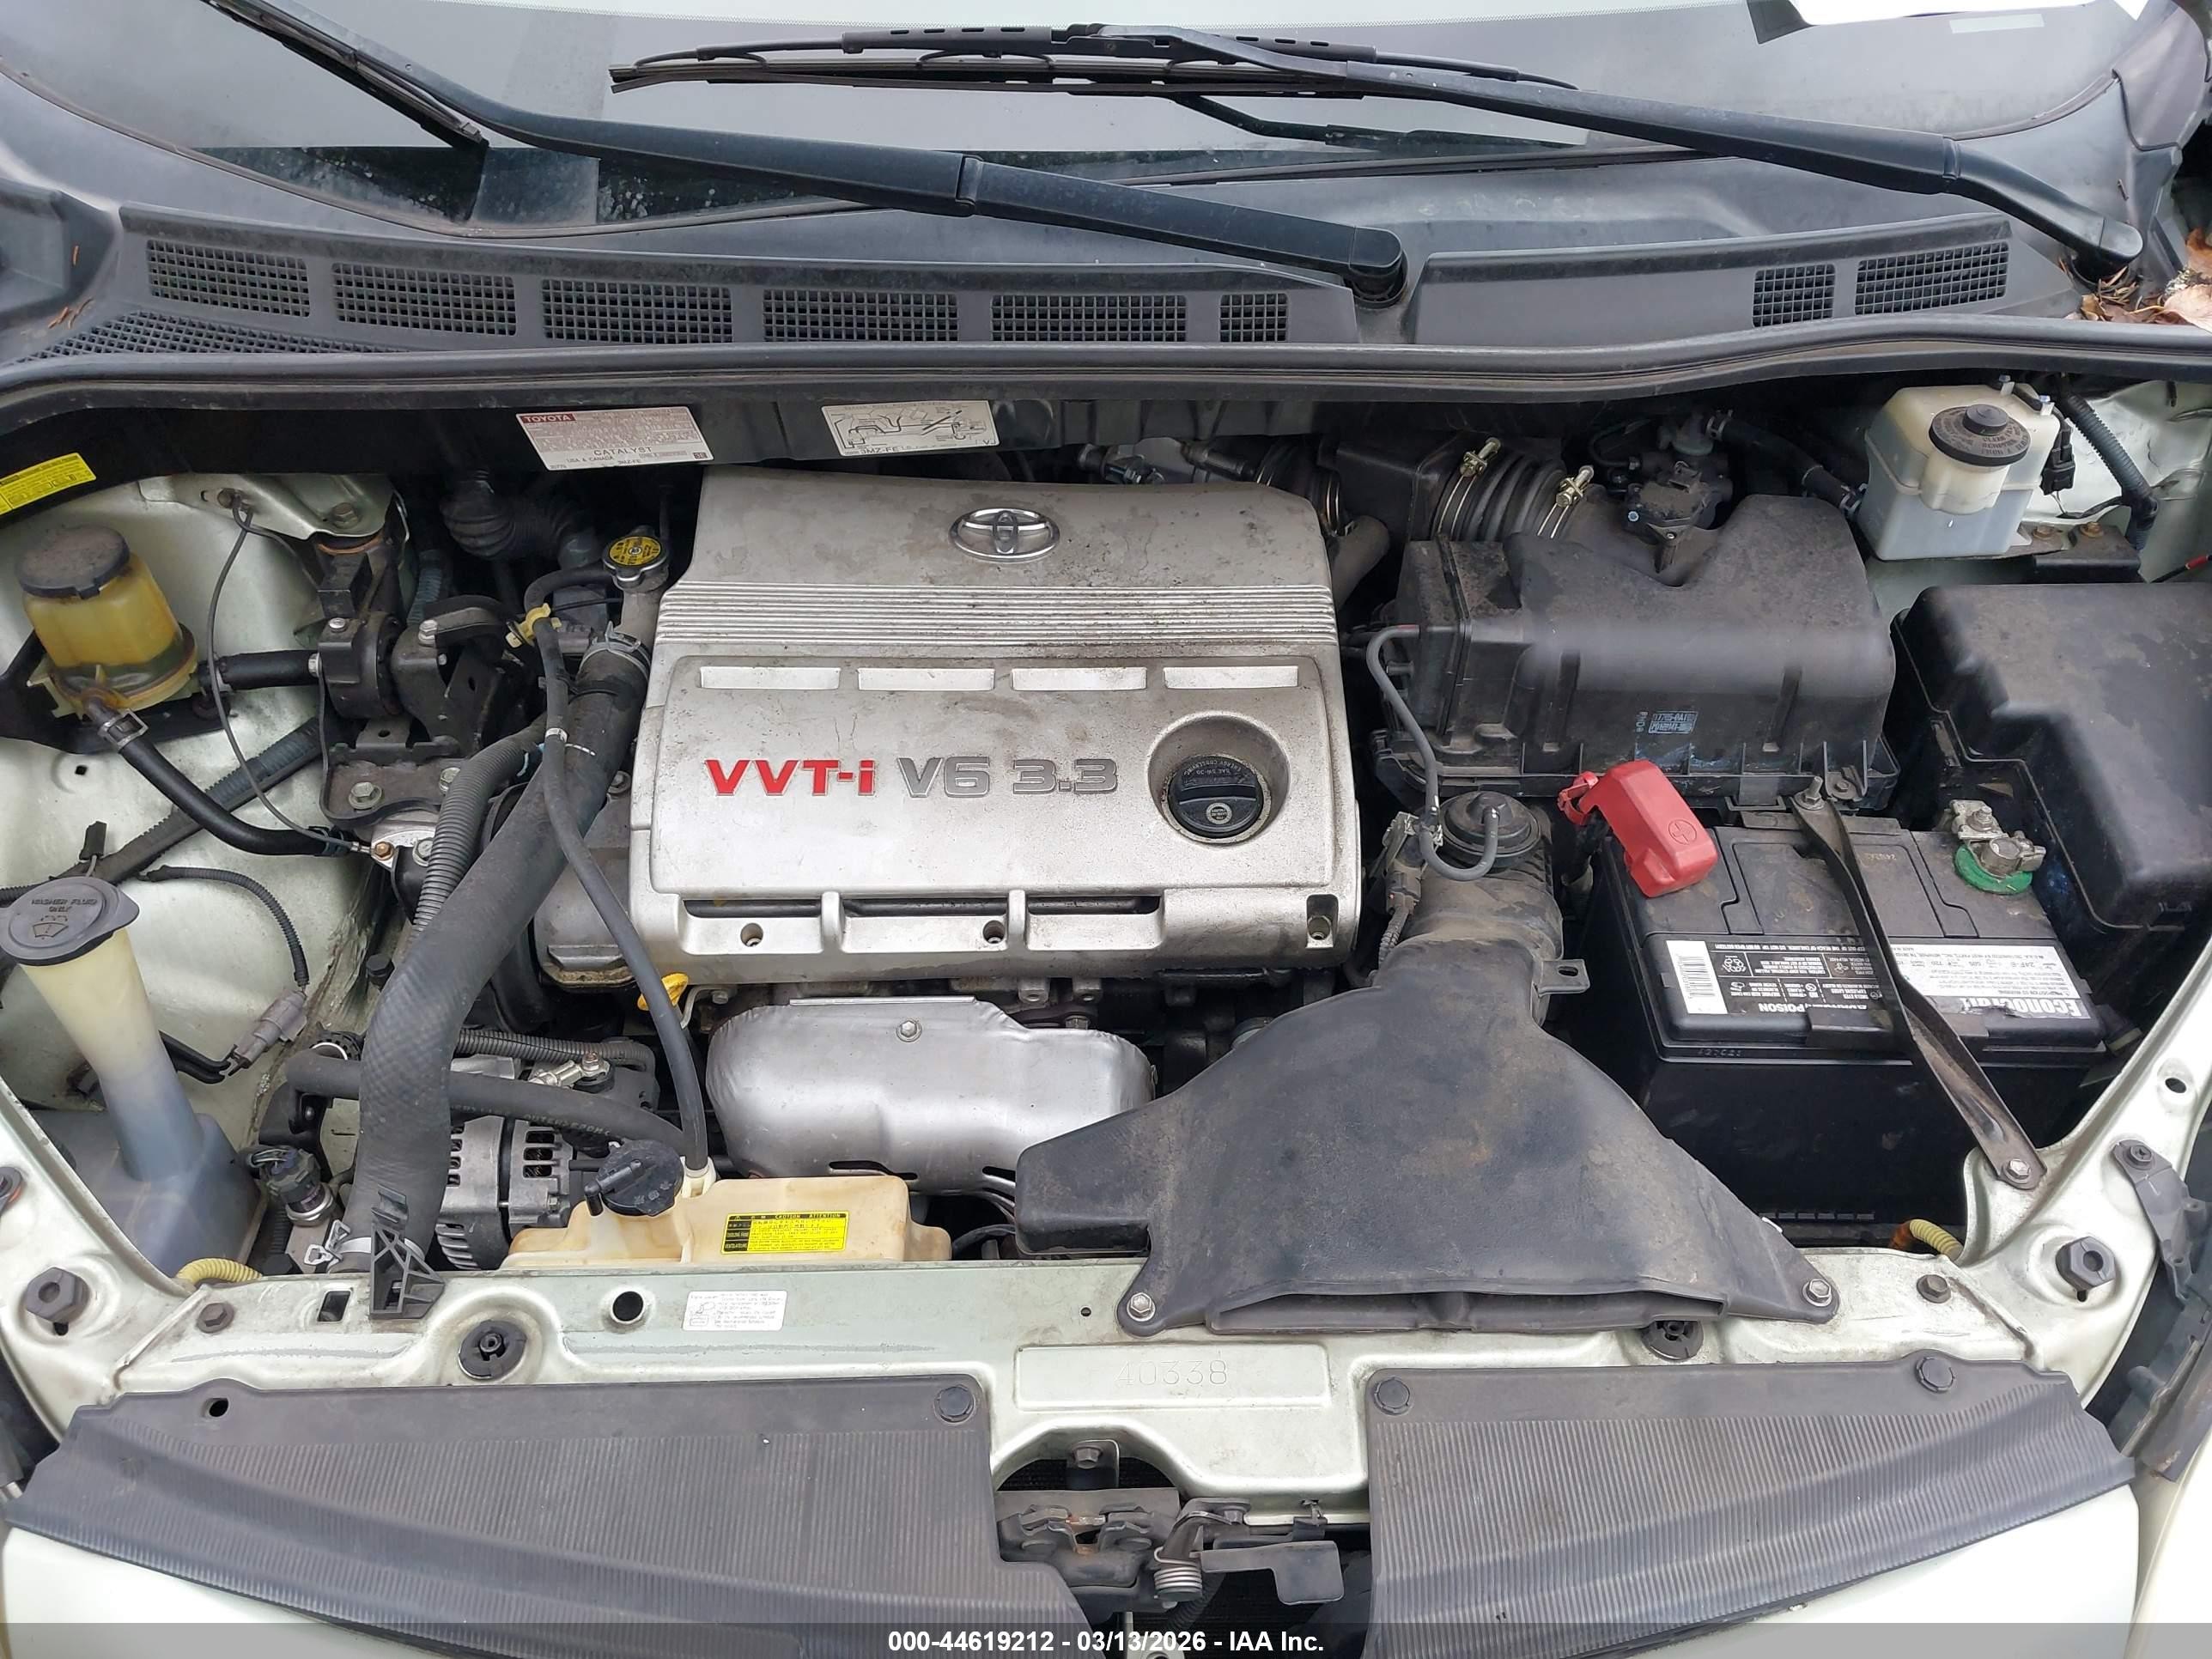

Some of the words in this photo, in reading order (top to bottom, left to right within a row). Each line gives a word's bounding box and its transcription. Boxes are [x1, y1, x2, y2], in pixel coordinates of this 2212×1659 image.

[593, 447, 653, 457] CATALYST
[705, 759, 876, 797] VVT-i
[897, 757, 991, 799] V6
[1013, 759, 1118, 795] 3.3
[1759, 1003, 1805, 1013] POISON
[1116, 1359, 1227, 1386] 40338
